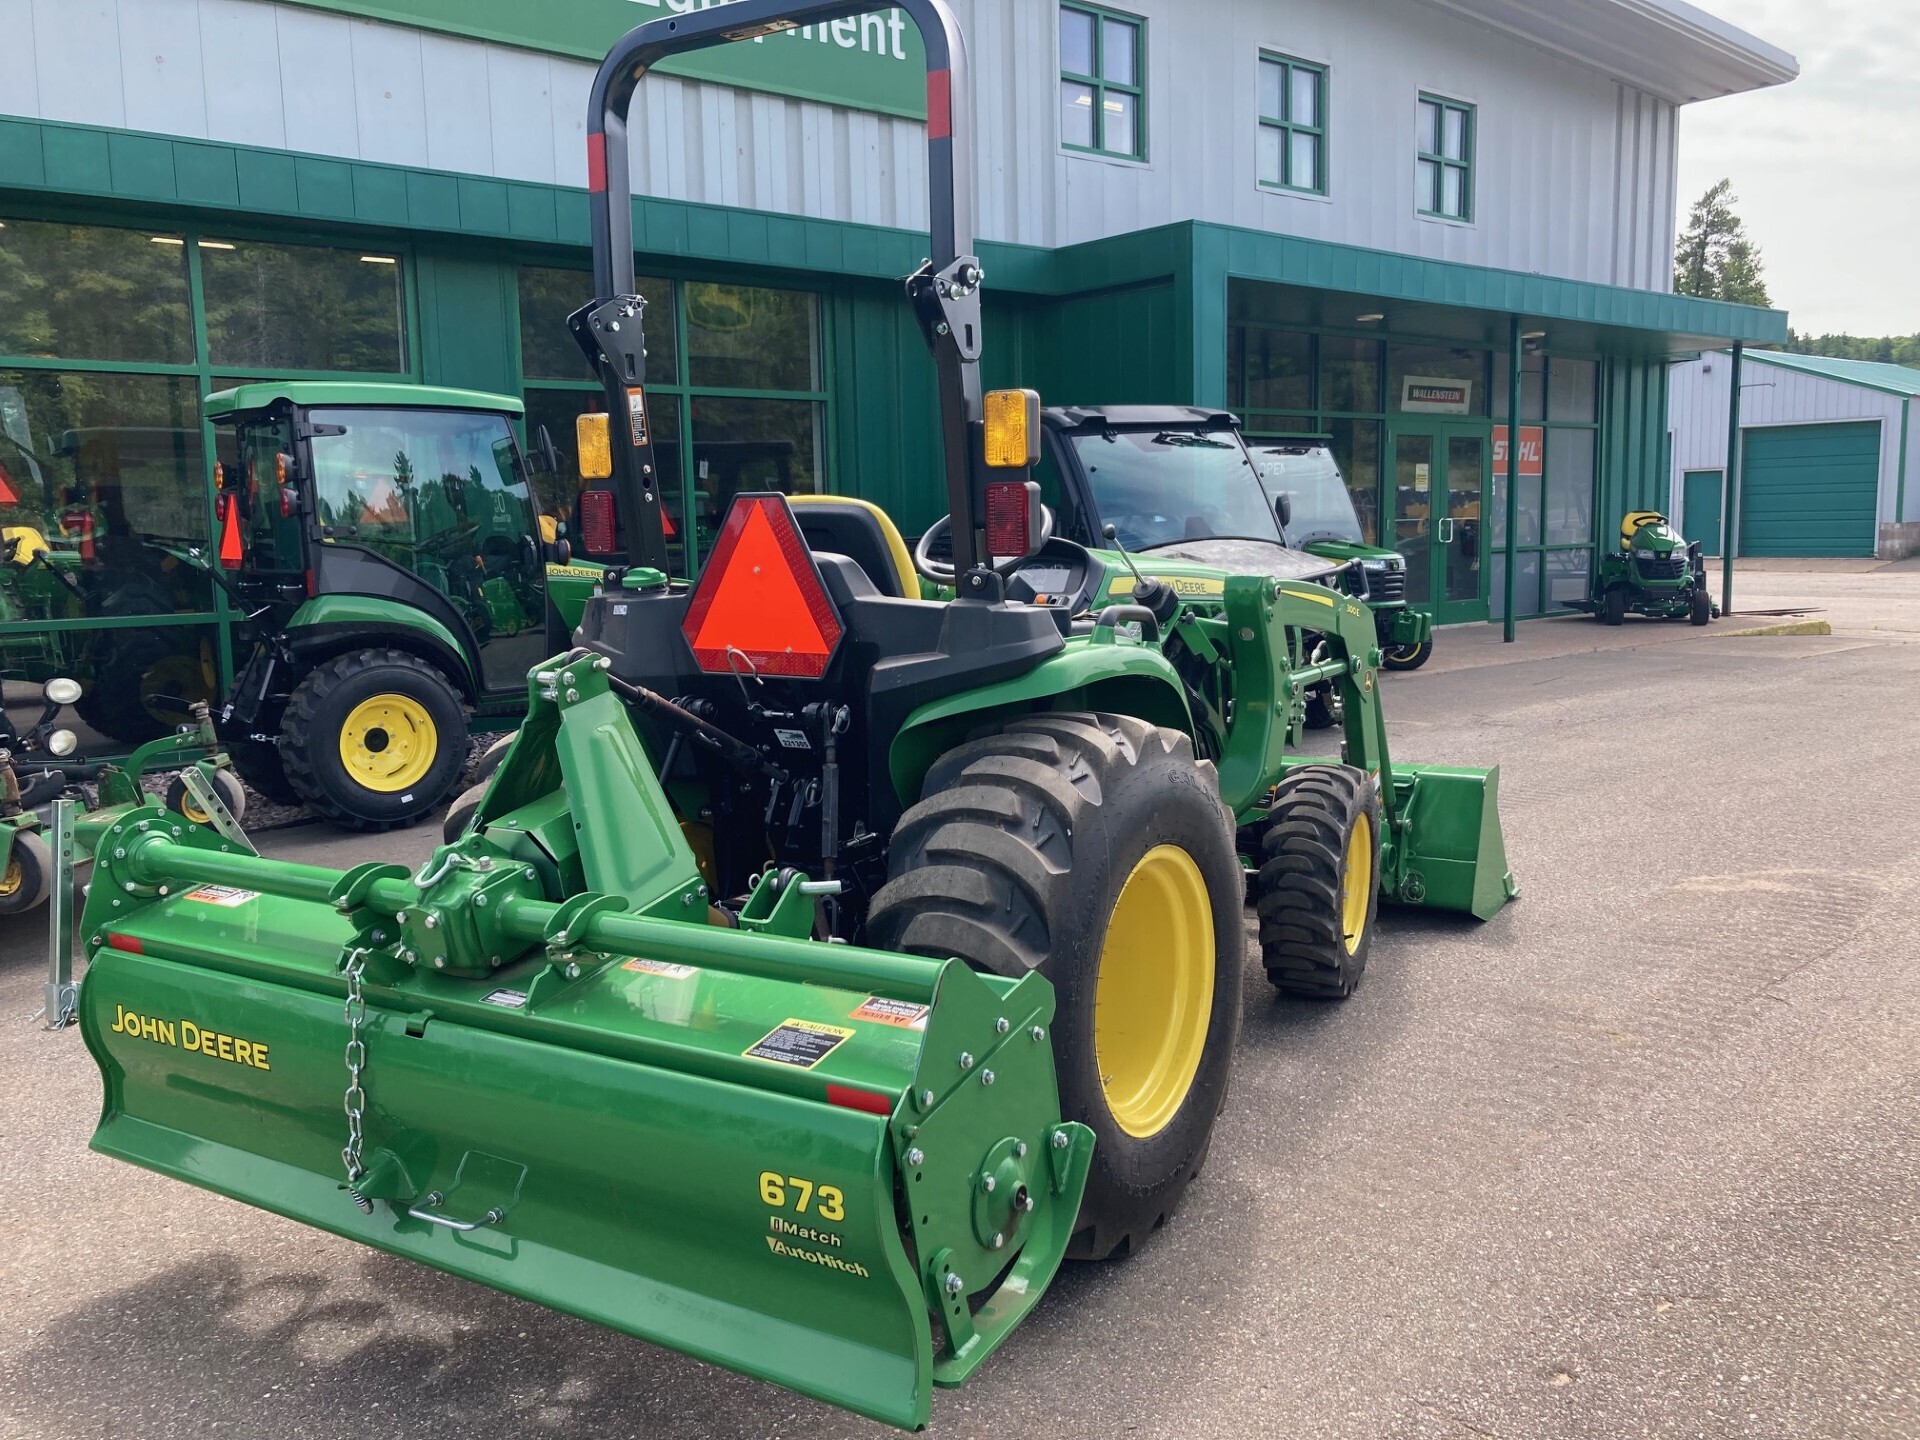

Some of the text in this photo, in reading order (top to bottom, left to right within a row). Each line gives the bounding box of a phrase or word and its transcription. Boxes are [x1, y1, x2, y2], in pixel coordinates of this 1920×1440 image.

[1412, 388, 1461, 401] WALLENSTEIN
[1492, 440, 1539, 461] SHL
[547, 567, 602, 578] JOHN DEERE
[1175, 580, 1207, 593] DEERE
[111, 1004, 271, 1071] JOHN DEERE
[799, 1022, 845, 1036] CAUTION
[759, 1171, 845, 1222] 673
[774, 1241, 870, 1278] AutoHitch
